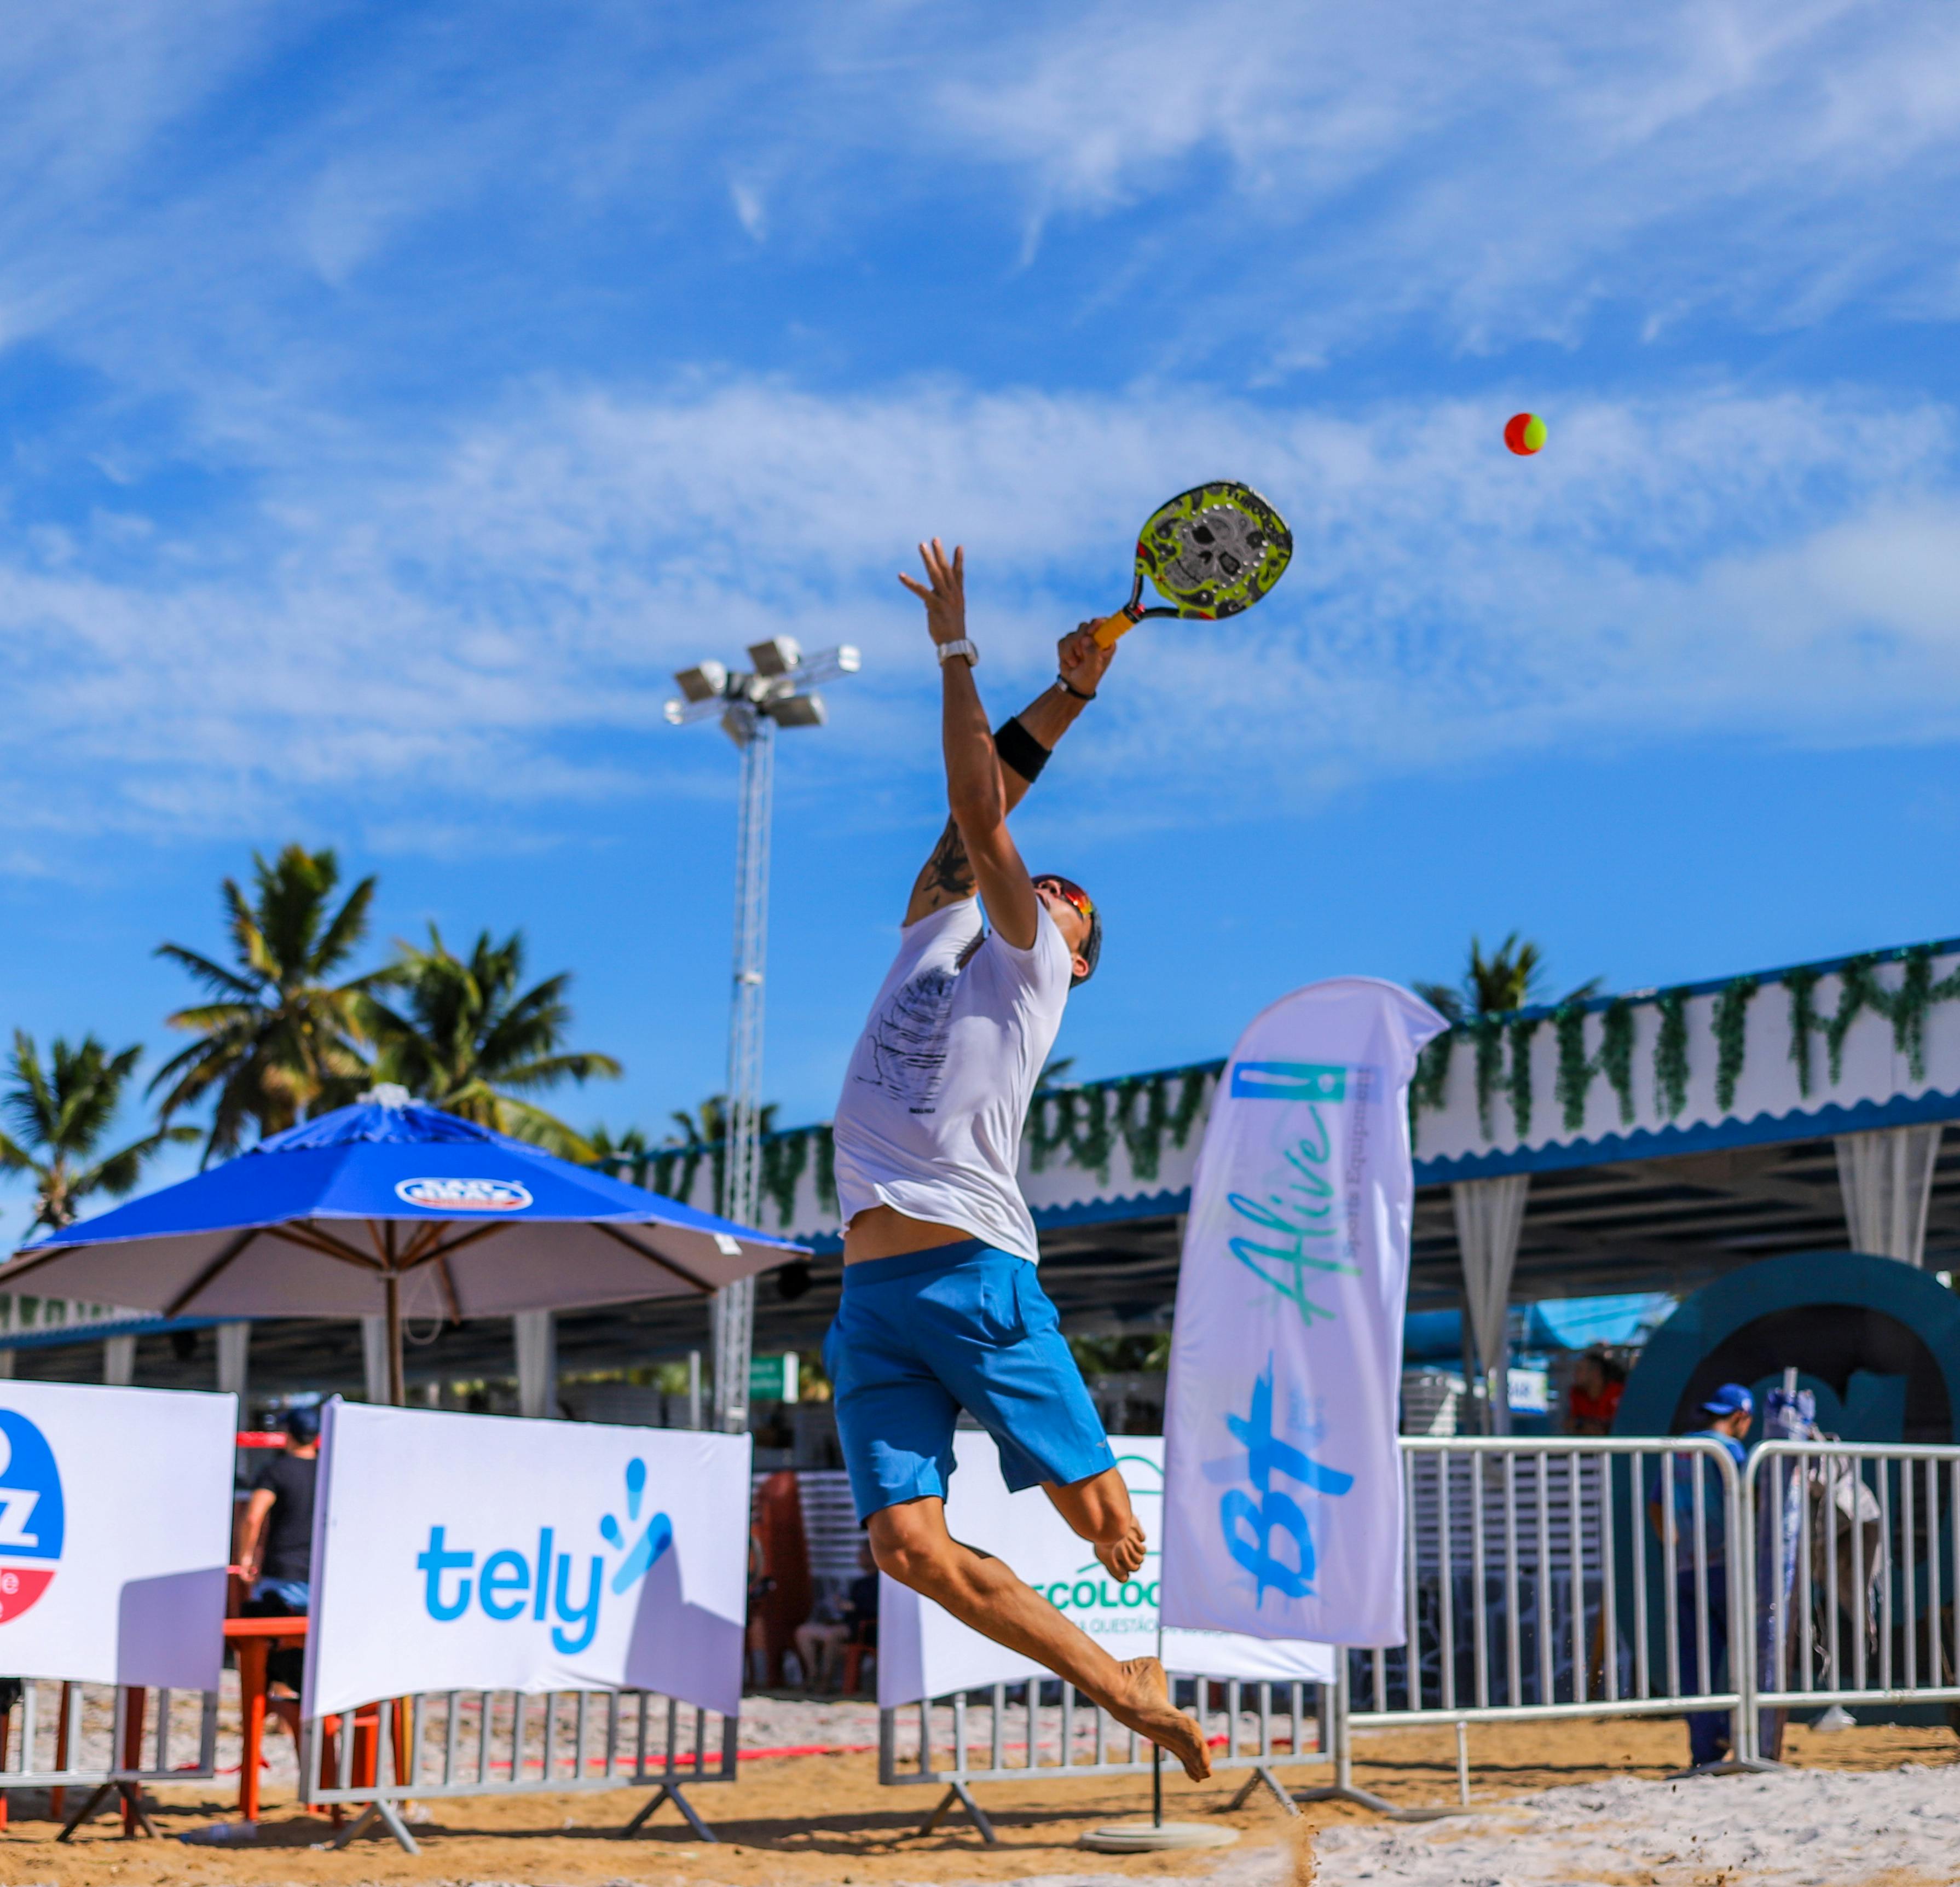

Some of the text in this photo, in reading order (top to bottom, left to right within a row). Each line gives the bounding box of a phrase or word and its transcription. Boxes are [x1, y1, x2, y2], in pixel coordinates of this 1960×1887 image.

[1345, 1067, 1370, 1186] Equipment
[1220, 1350, 1356, 1611] BT
[417, 1526, 604, 1654] tely
